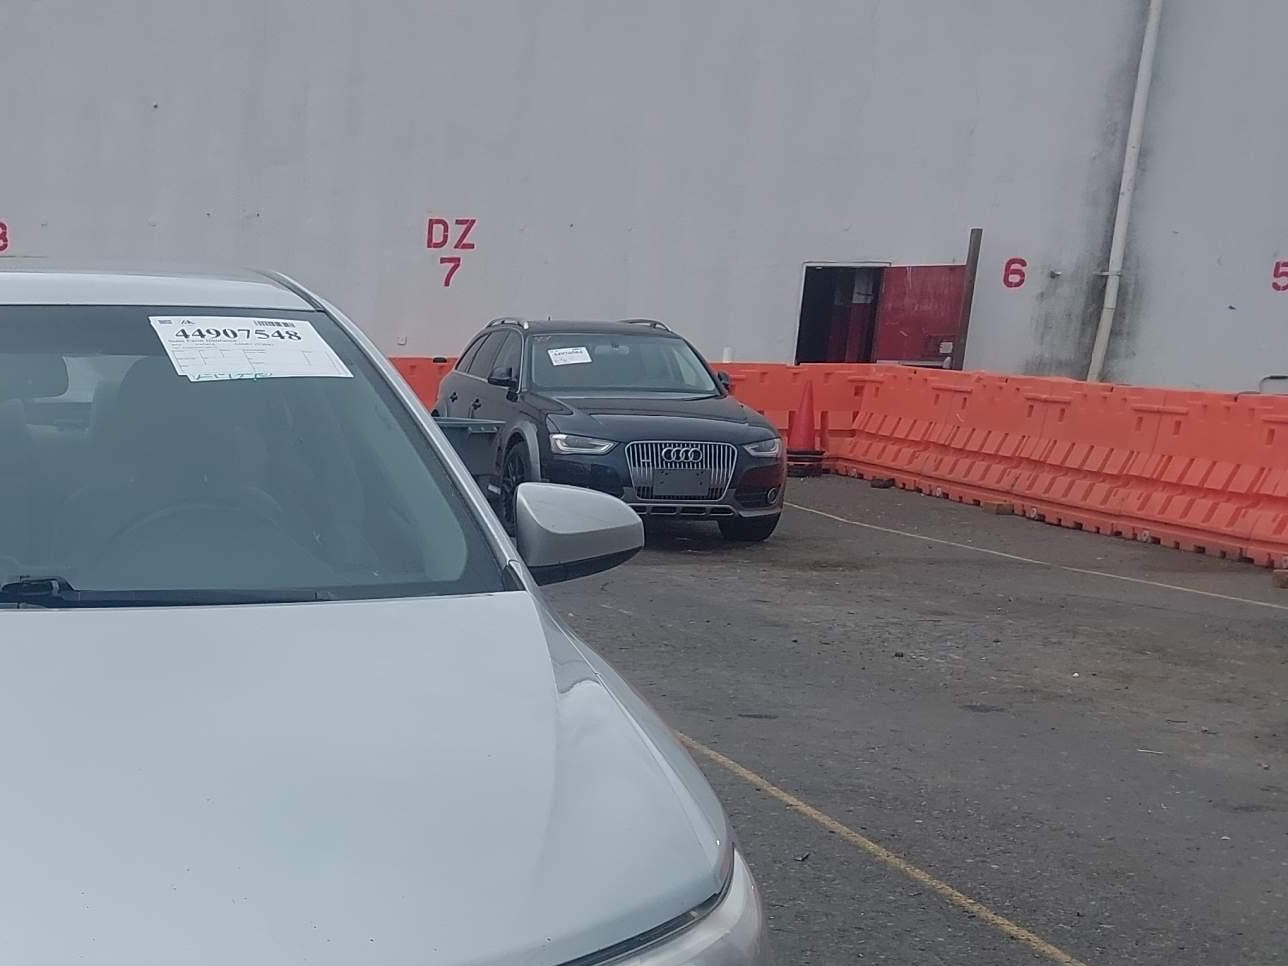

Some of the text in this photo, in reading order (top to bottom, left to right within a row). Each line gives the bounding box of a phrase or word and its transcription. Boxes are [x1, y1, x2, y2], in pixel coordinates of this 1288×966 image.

[427, 218, 476, 249] DZ
[439, 256, 461, 287] 7
[1003, 257, 1027, 288] 6
[1272, 261, 1288, 291] 5
[175, 328, 302, 341] 44907548
